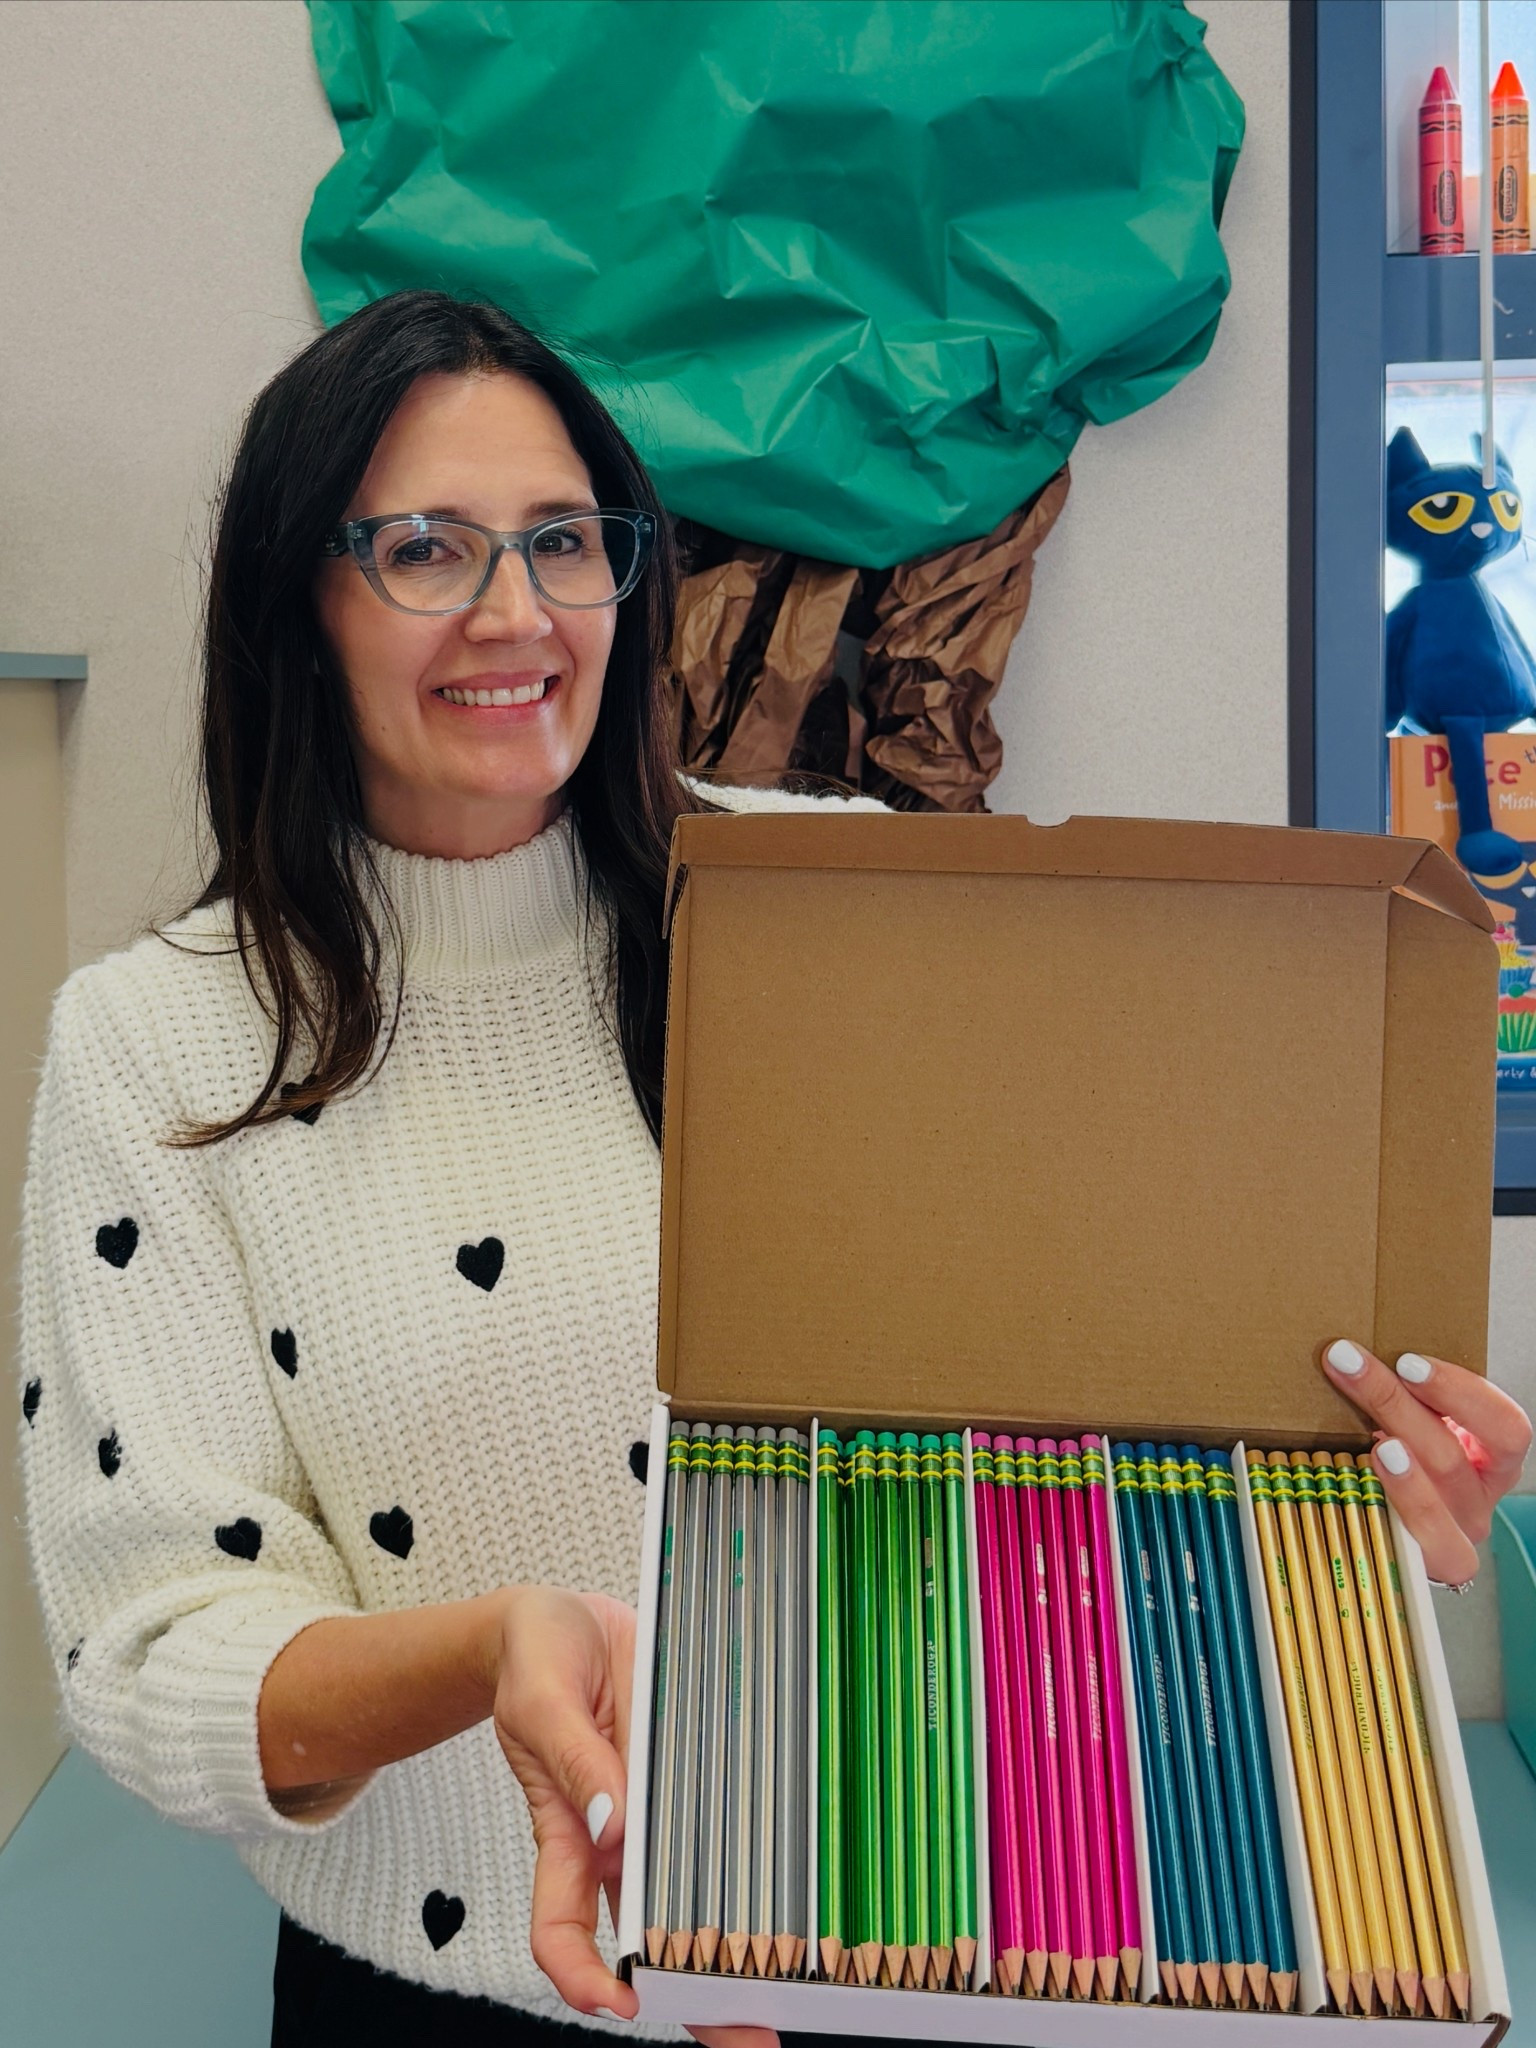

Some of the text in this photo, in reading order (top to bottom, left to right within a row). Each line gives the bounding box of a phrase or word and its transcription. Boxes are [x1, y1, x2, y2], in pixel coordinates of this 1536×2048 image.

[1502, 170, 1513, 217] Crayola
[1423, 744, 1521, 787] Pe
[1498, 791, 1536, 810] Missi
